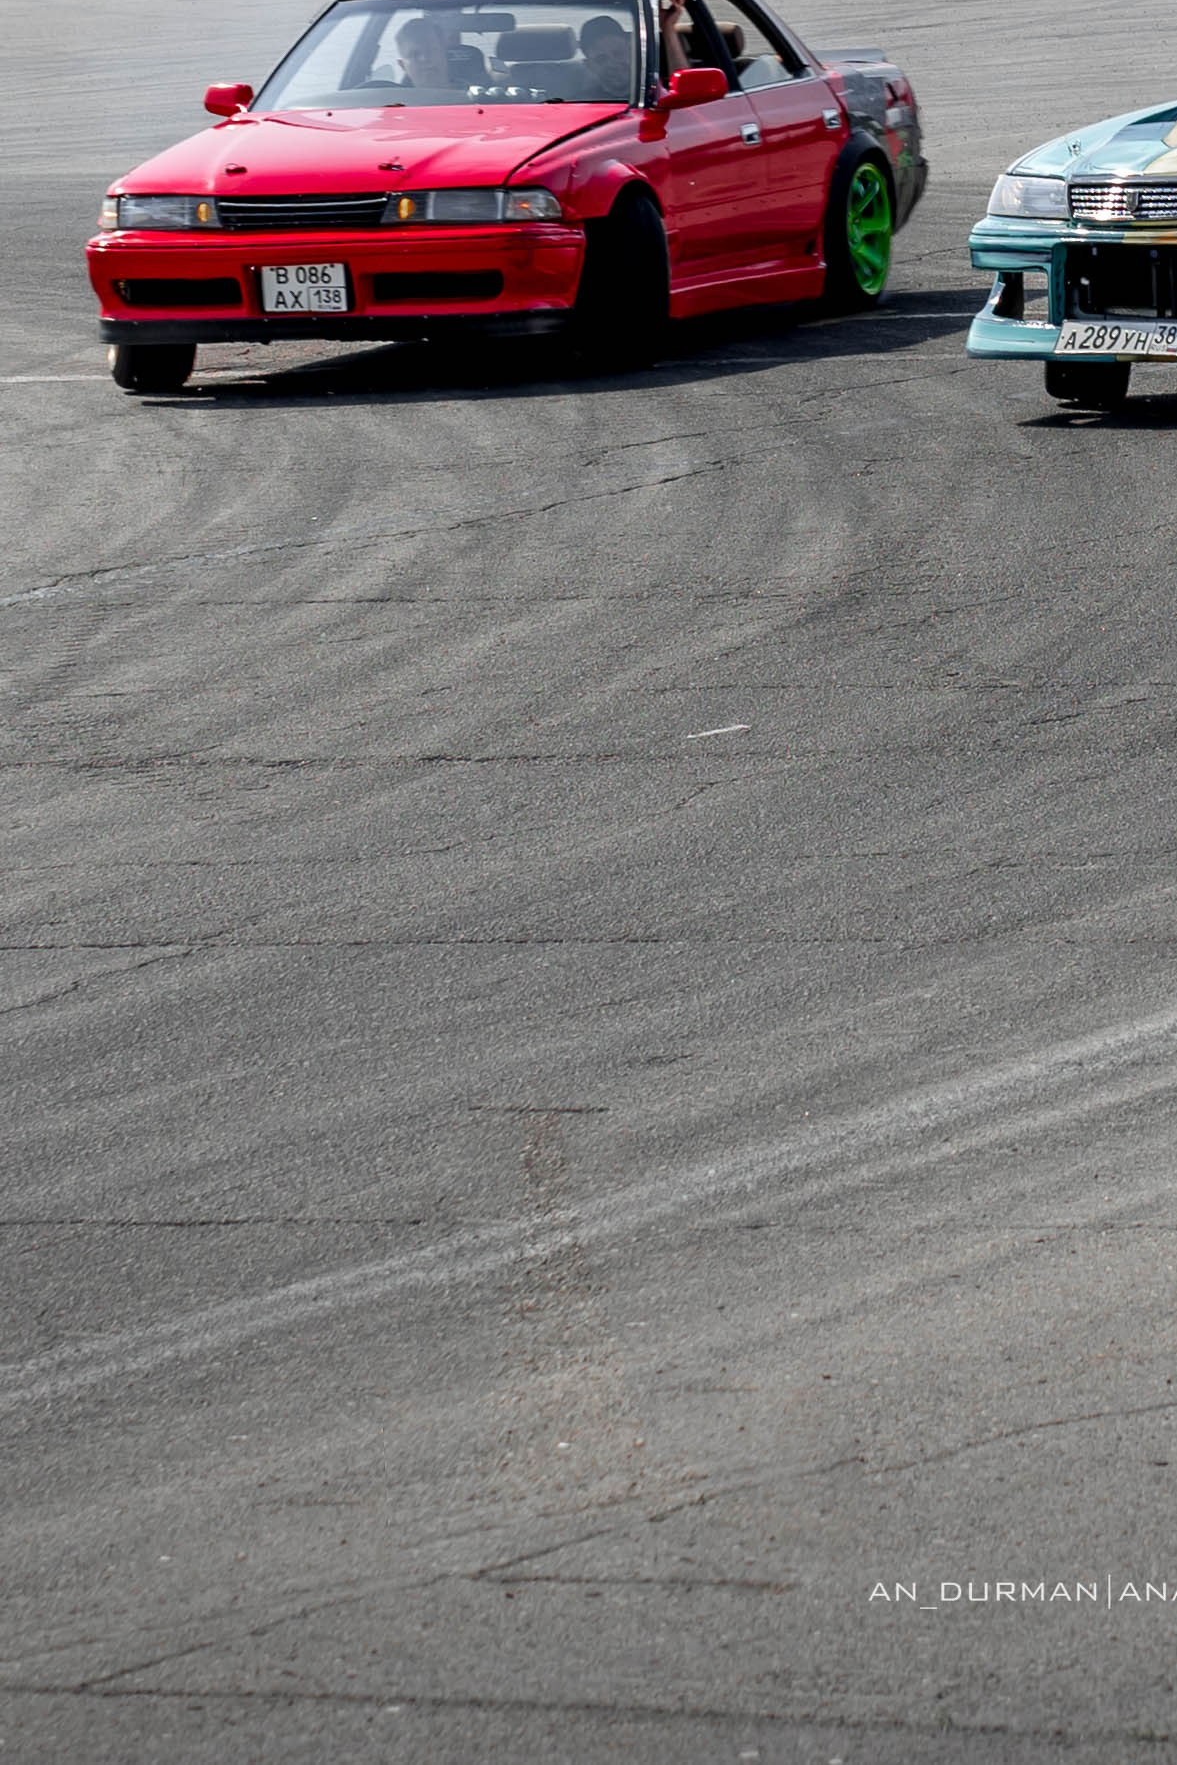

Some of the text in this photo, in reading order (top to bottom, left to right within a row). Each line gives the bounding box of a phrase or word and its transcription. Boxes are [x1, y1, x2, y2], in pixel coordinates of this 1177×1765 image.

[295, 265, 332, 284] 086
[313, 289, 342, 304] 138
[1154, 325, 1177, 345] 38
